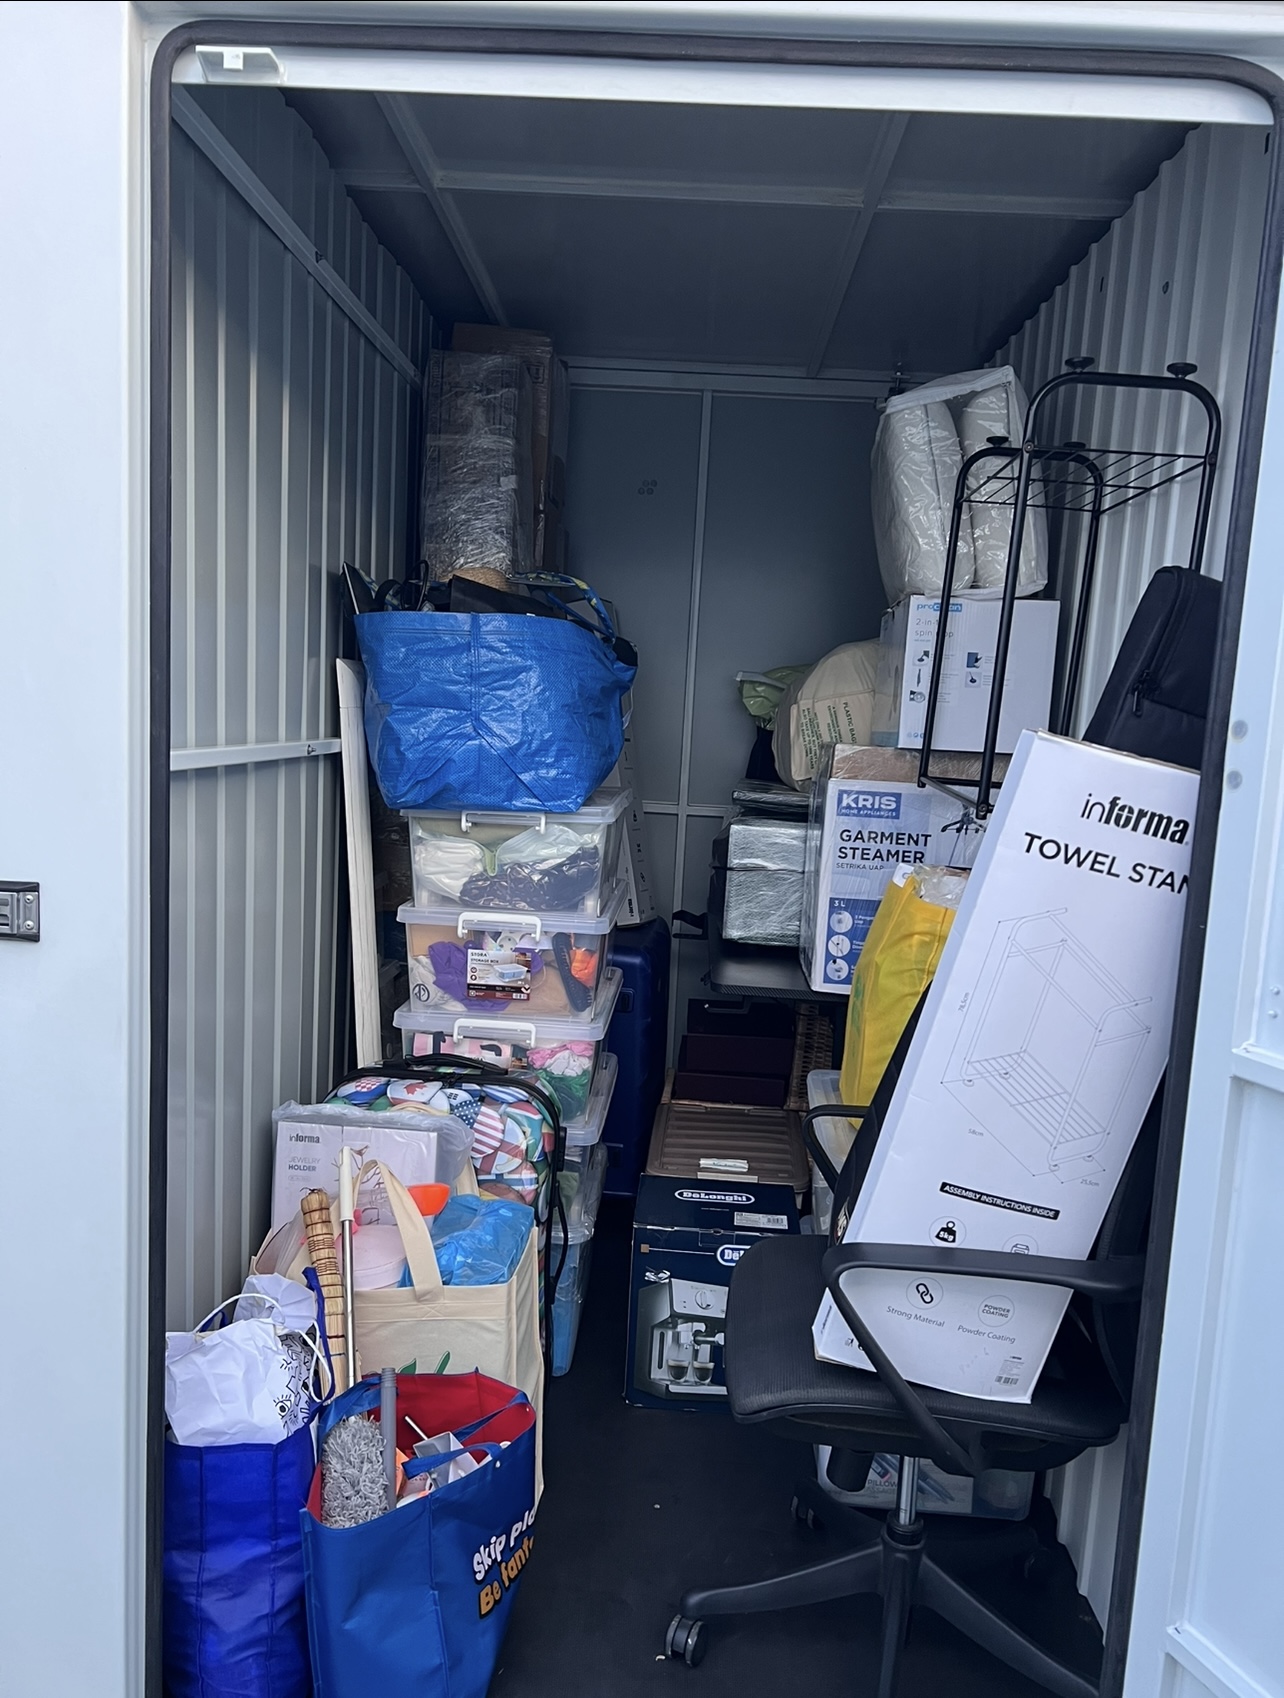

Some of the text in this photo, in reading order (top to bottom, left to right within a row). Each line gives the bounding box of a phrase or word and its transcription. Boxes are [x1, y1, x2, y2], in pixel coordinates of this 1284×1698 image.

[843, 702, 857, 743] PLASTIC BAG
[841, 793, 897, 809] KRIS
[1080, 793, 1190, 845] informa
[840, 829, 932, 847] GARMENT
[838, 846, 925, 863] STEAMER
[1024, 831, 1120, 878] TOWEL
[289, 1133, 320, 1144] informa
[288, 1156, 320, 1164] JEWELRY
[288, 1164, 317, 1172] HOLDER
[943, 1185, 1056, 1218] ASSEMBLY INSTRUCTIONS INSIDE
[938, 1231, 954, 1241] 5kg
[886, 1306, 945, 1328] Strong Material
[981, 1309, 1009, 1318] COATING
[983, 1304, 1011, 1314] POWDER
[957, 1325, 1016, 1344] Powder Coating
[473, 1534, 506, 1581] Skip
[480, 1580, 501, 1615] Be
